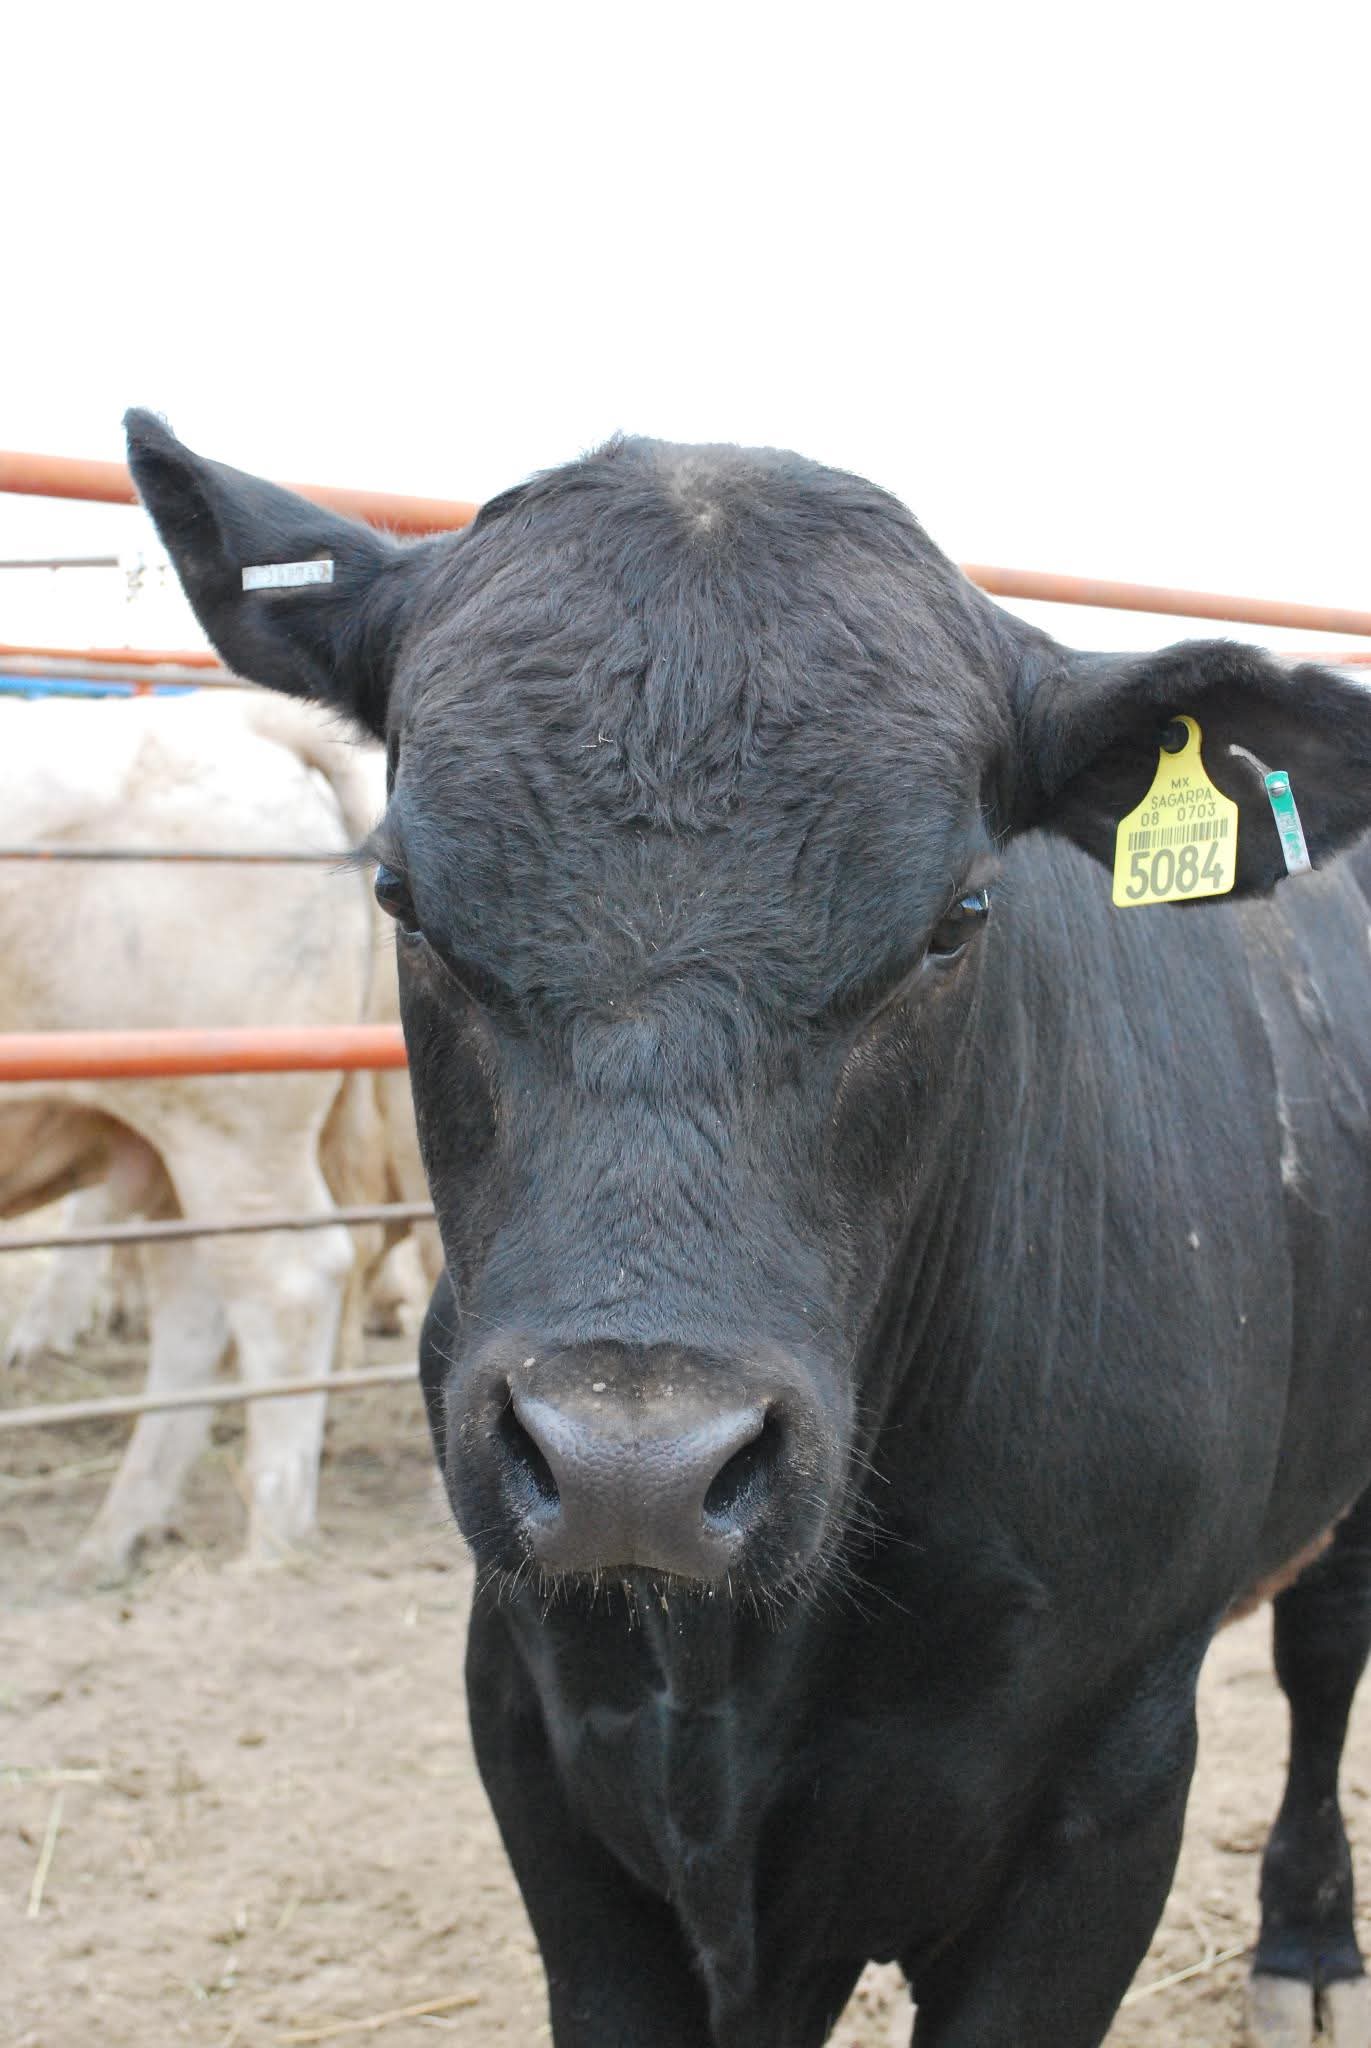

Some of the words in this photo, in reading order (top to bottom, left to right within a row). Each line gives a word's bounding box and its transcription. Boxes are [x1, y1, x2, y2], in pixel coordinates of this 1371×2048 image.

[1171, 777, 1190, 789] MX
[1151, 788, 1213, 810] SAGARPA
[1141, 812, 1160, 827] 08
[1177, 802, 1216, 821] 0703
[1126, 841, 1224, 900] 5084
